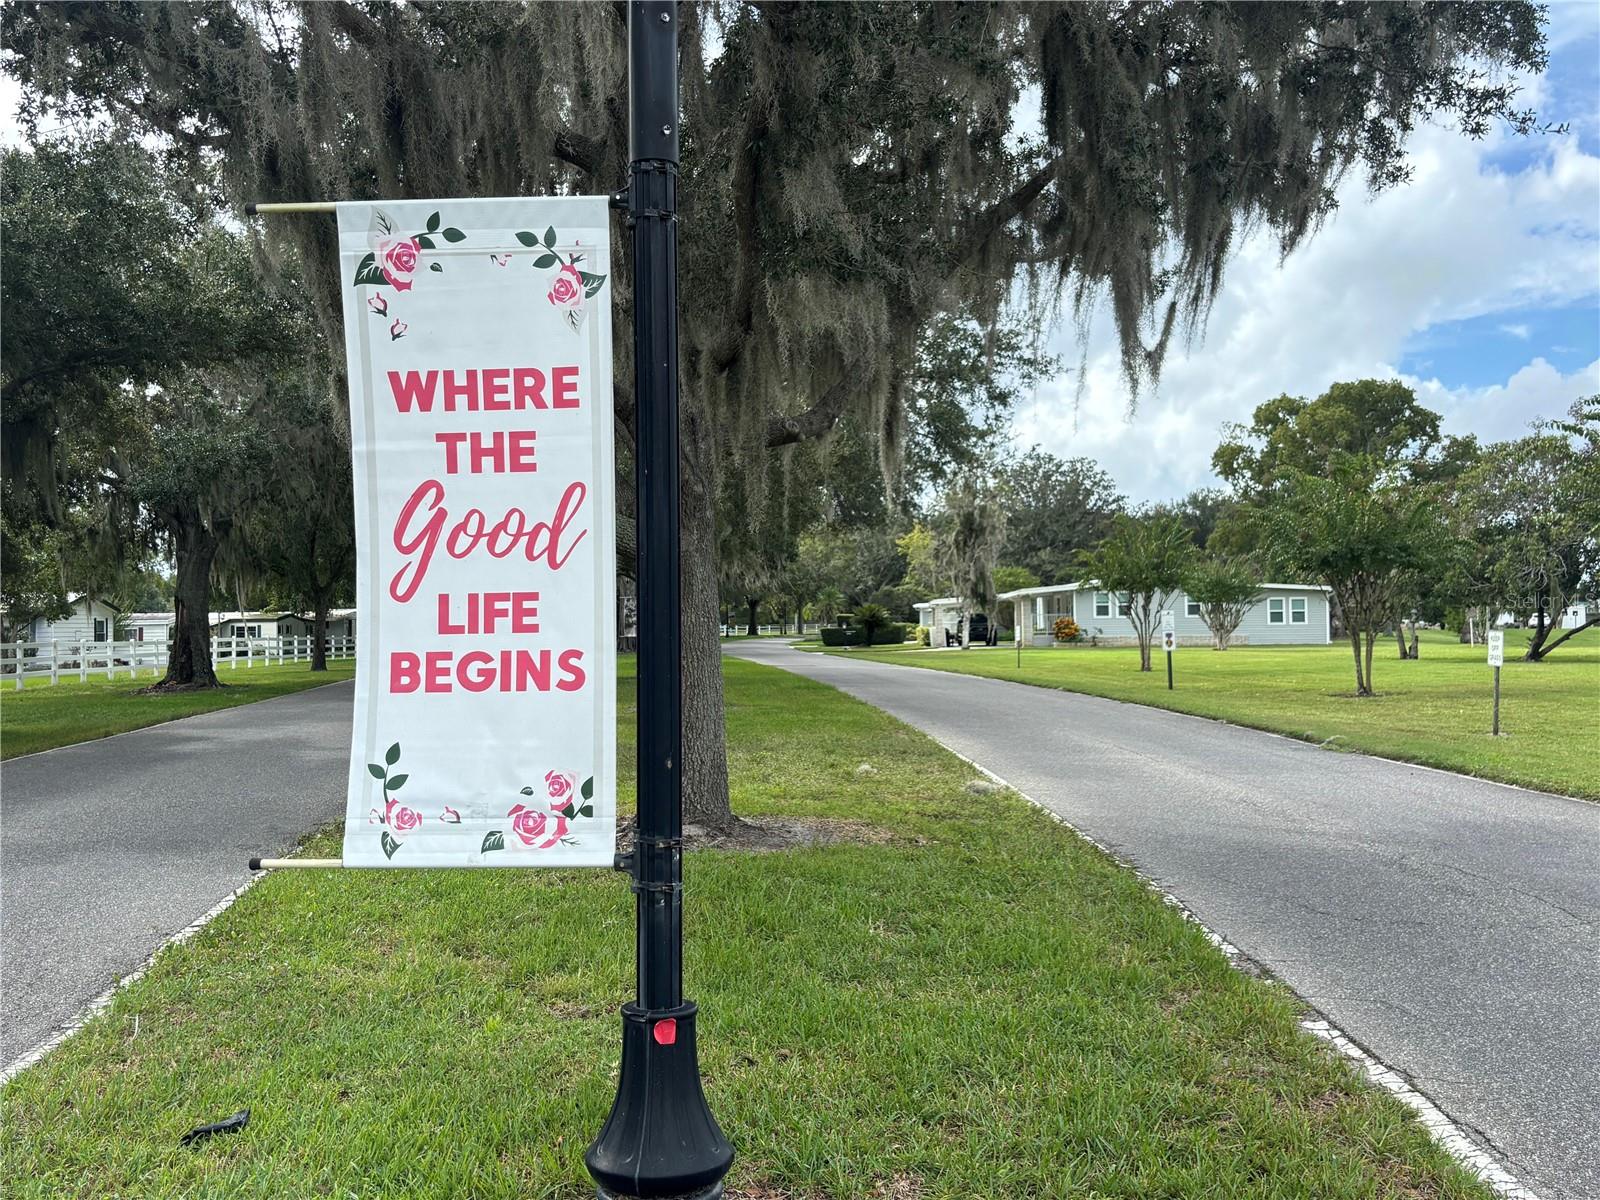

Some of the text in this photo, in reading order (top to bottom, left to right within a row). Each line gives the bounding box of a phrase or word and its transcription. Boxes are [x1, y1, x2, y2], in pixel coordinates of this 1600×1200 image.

[387, 366, 581, 413] WHERE
[435, 431, 538, 475] THE
[389, 479, 588, 603] Good
[438, 591, 540, 636] LIFE
[389, 649, 587, 694] BEGINS
